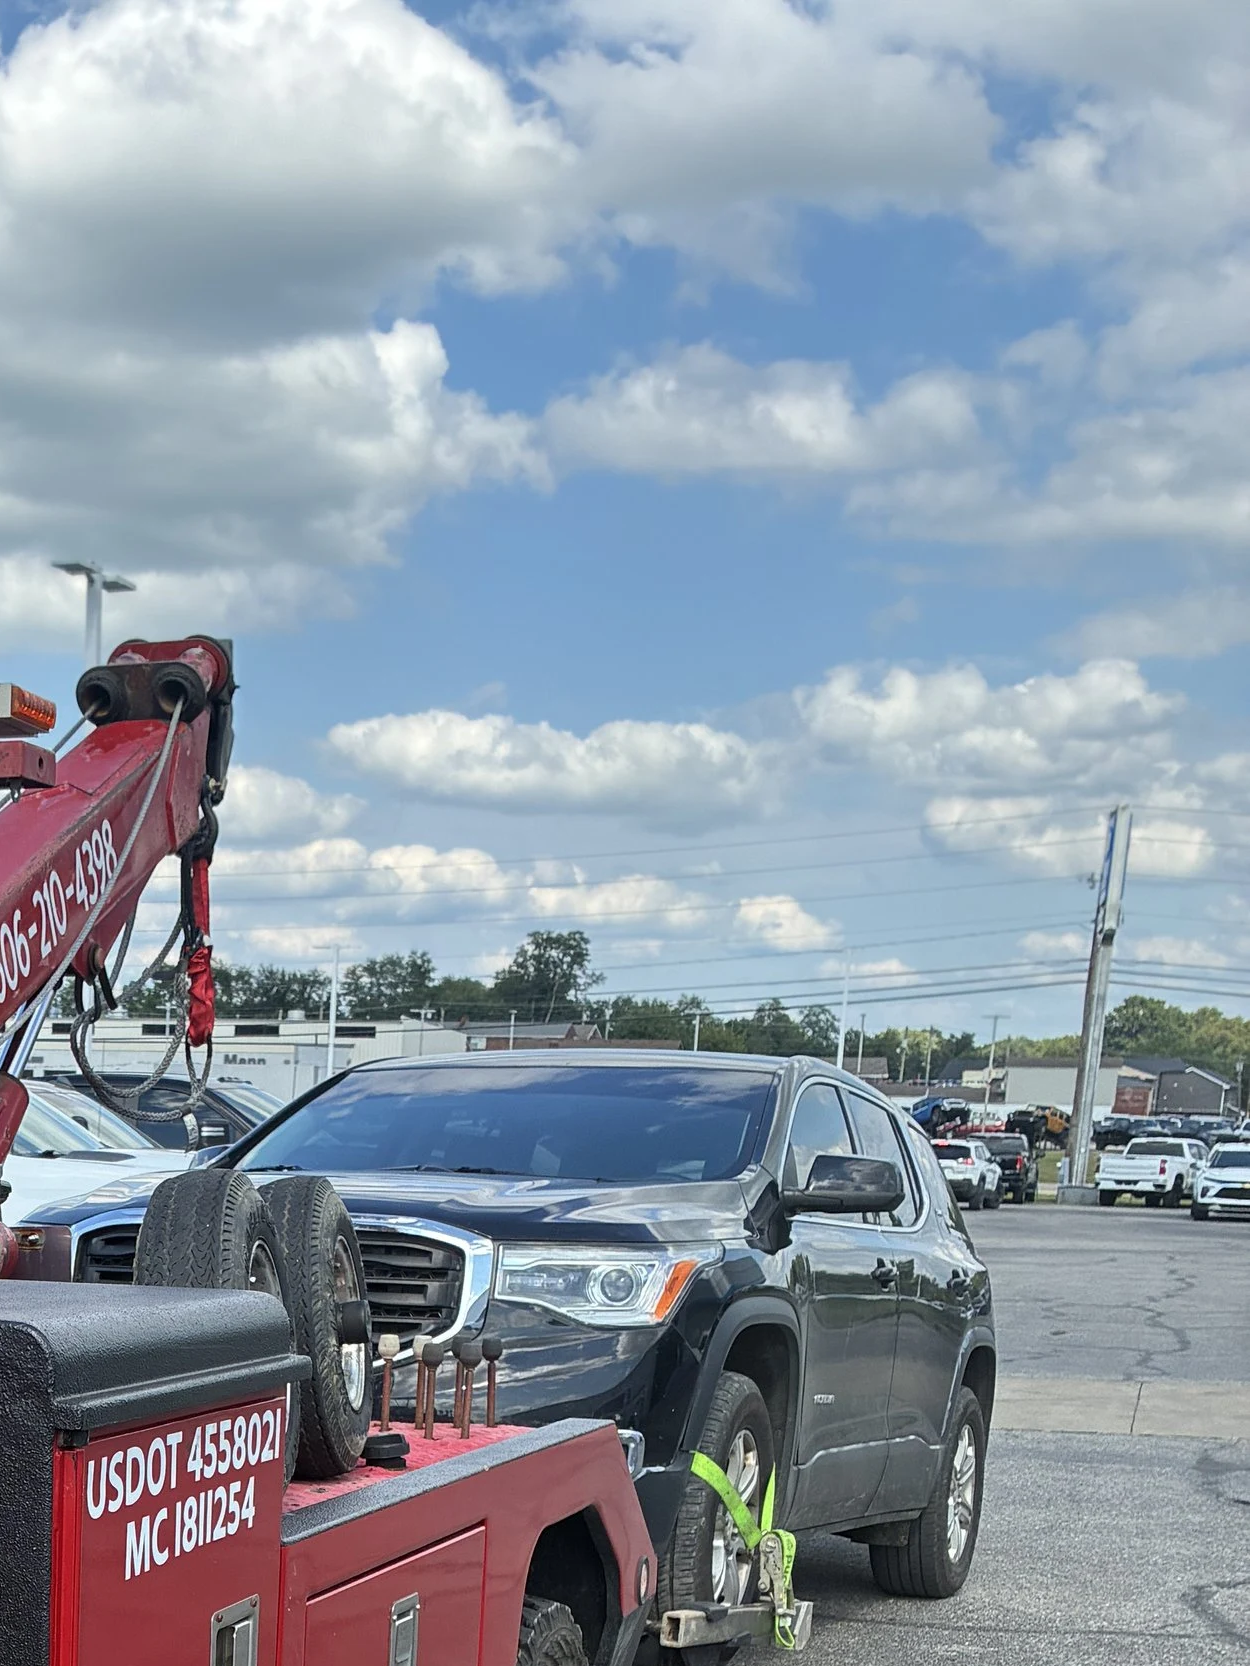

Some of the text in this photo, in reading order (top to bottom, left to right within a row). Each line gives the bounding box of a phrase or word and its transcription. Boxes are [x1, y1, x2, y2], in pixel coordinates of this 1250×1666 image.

[86, 1408, 282, 1520] USDOT 4558021
[124, 1476, 256, 1581] MC 1811254
